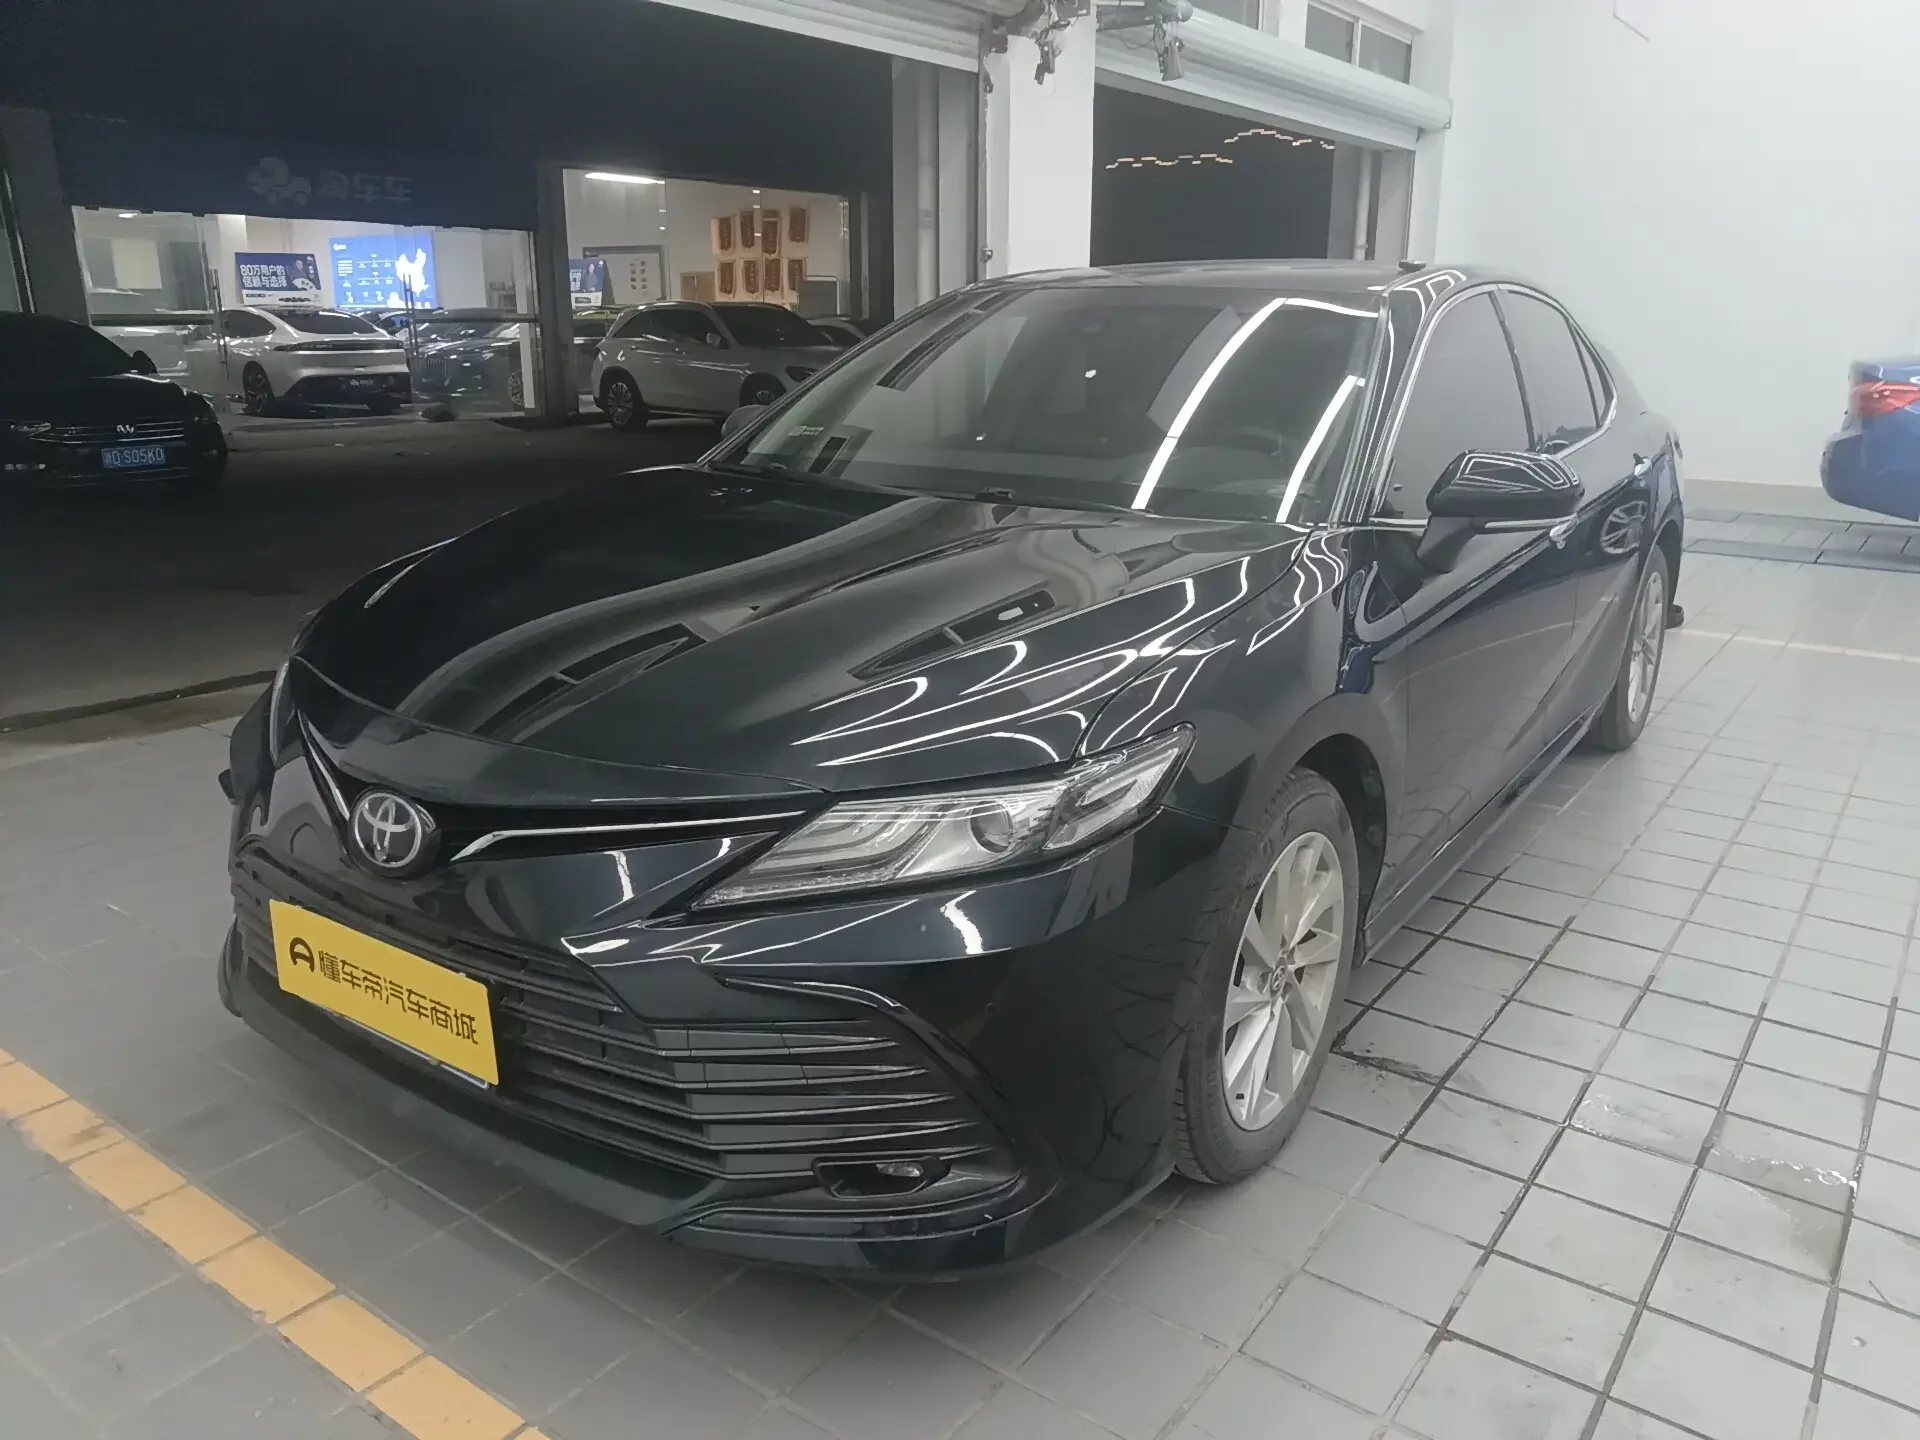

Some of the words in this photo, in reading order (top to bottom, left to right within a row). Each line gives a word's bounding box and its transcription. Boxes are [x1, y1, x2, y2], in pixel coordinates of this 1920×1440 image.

[240, 264, 285, 276] 80万用户的
[242, 275, 287, 288] 信赖与选择
[318, 950, 479, 1045] 懂车帝汽车商城
